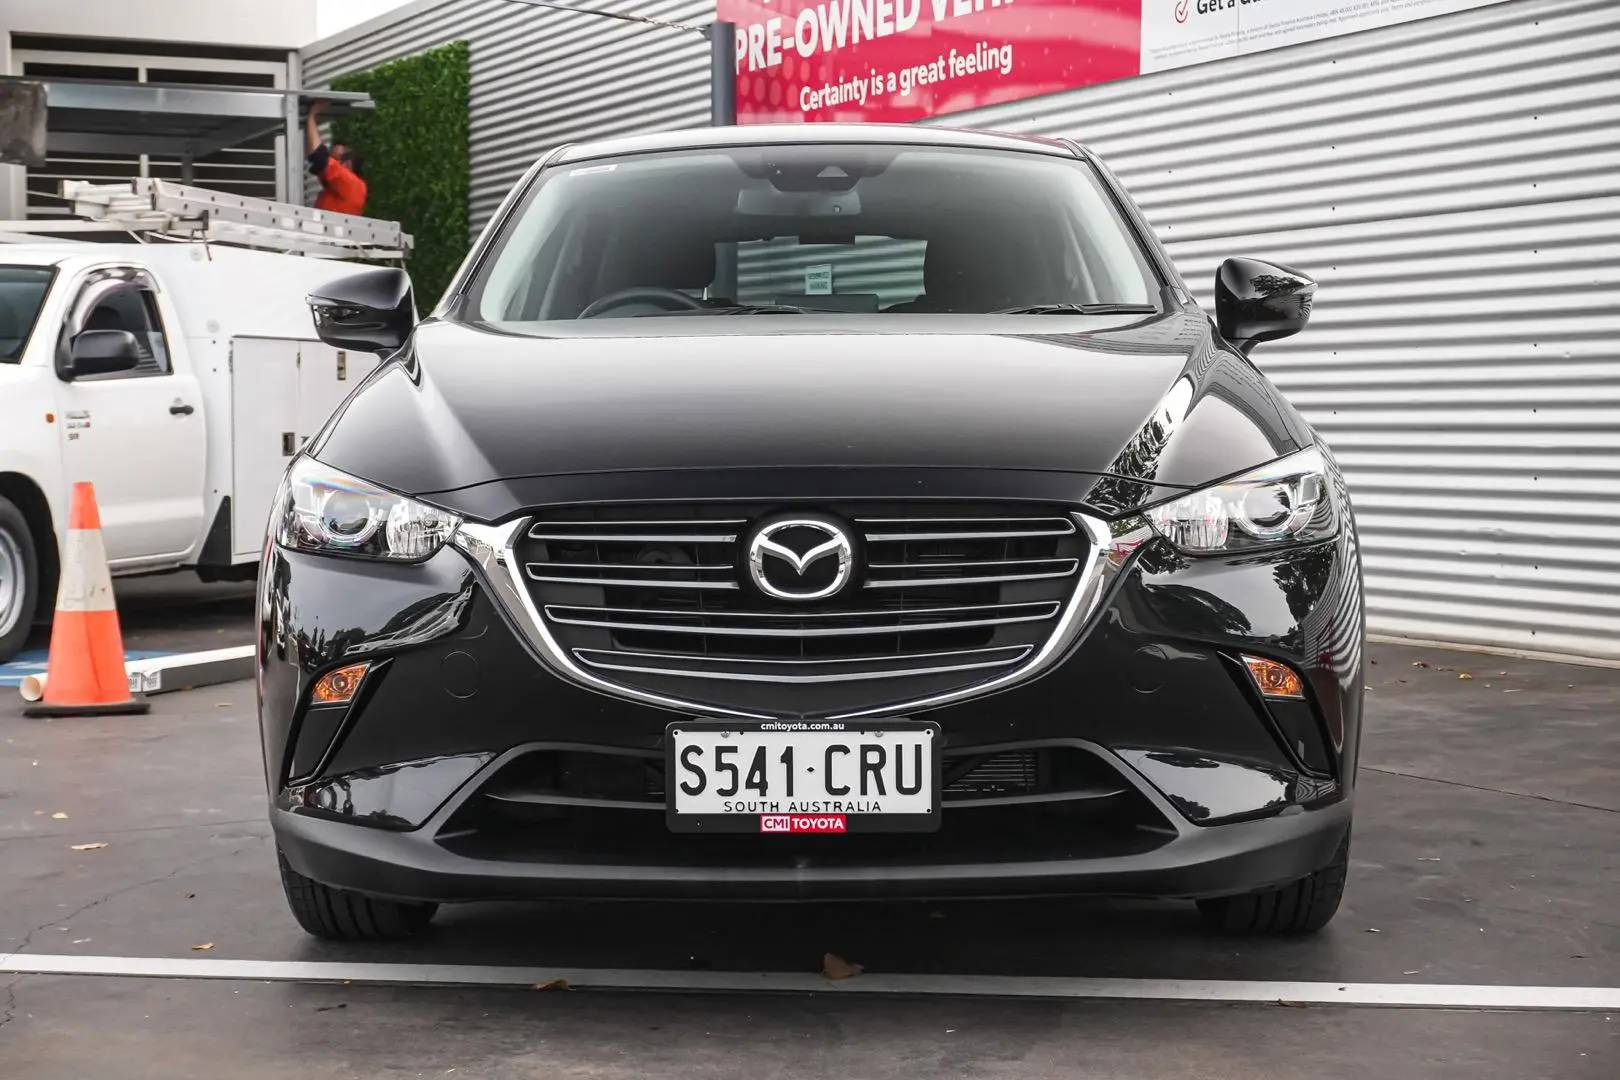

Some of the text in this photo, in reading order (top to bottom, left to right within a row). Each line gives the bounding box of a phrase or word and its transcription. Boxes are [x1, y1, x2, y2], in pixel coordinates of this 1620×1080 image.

[736, 0, 921, 76] PRE-OWNED
[800, 41, 1012, 111] Certainty is a great feeling
[760, 722, 845, 732] cmitoyota.com.au
[724, 801, 881, 812] SOUTH AUSTRALIA
[764, 818, 844, 830] CMI TOYOTA
